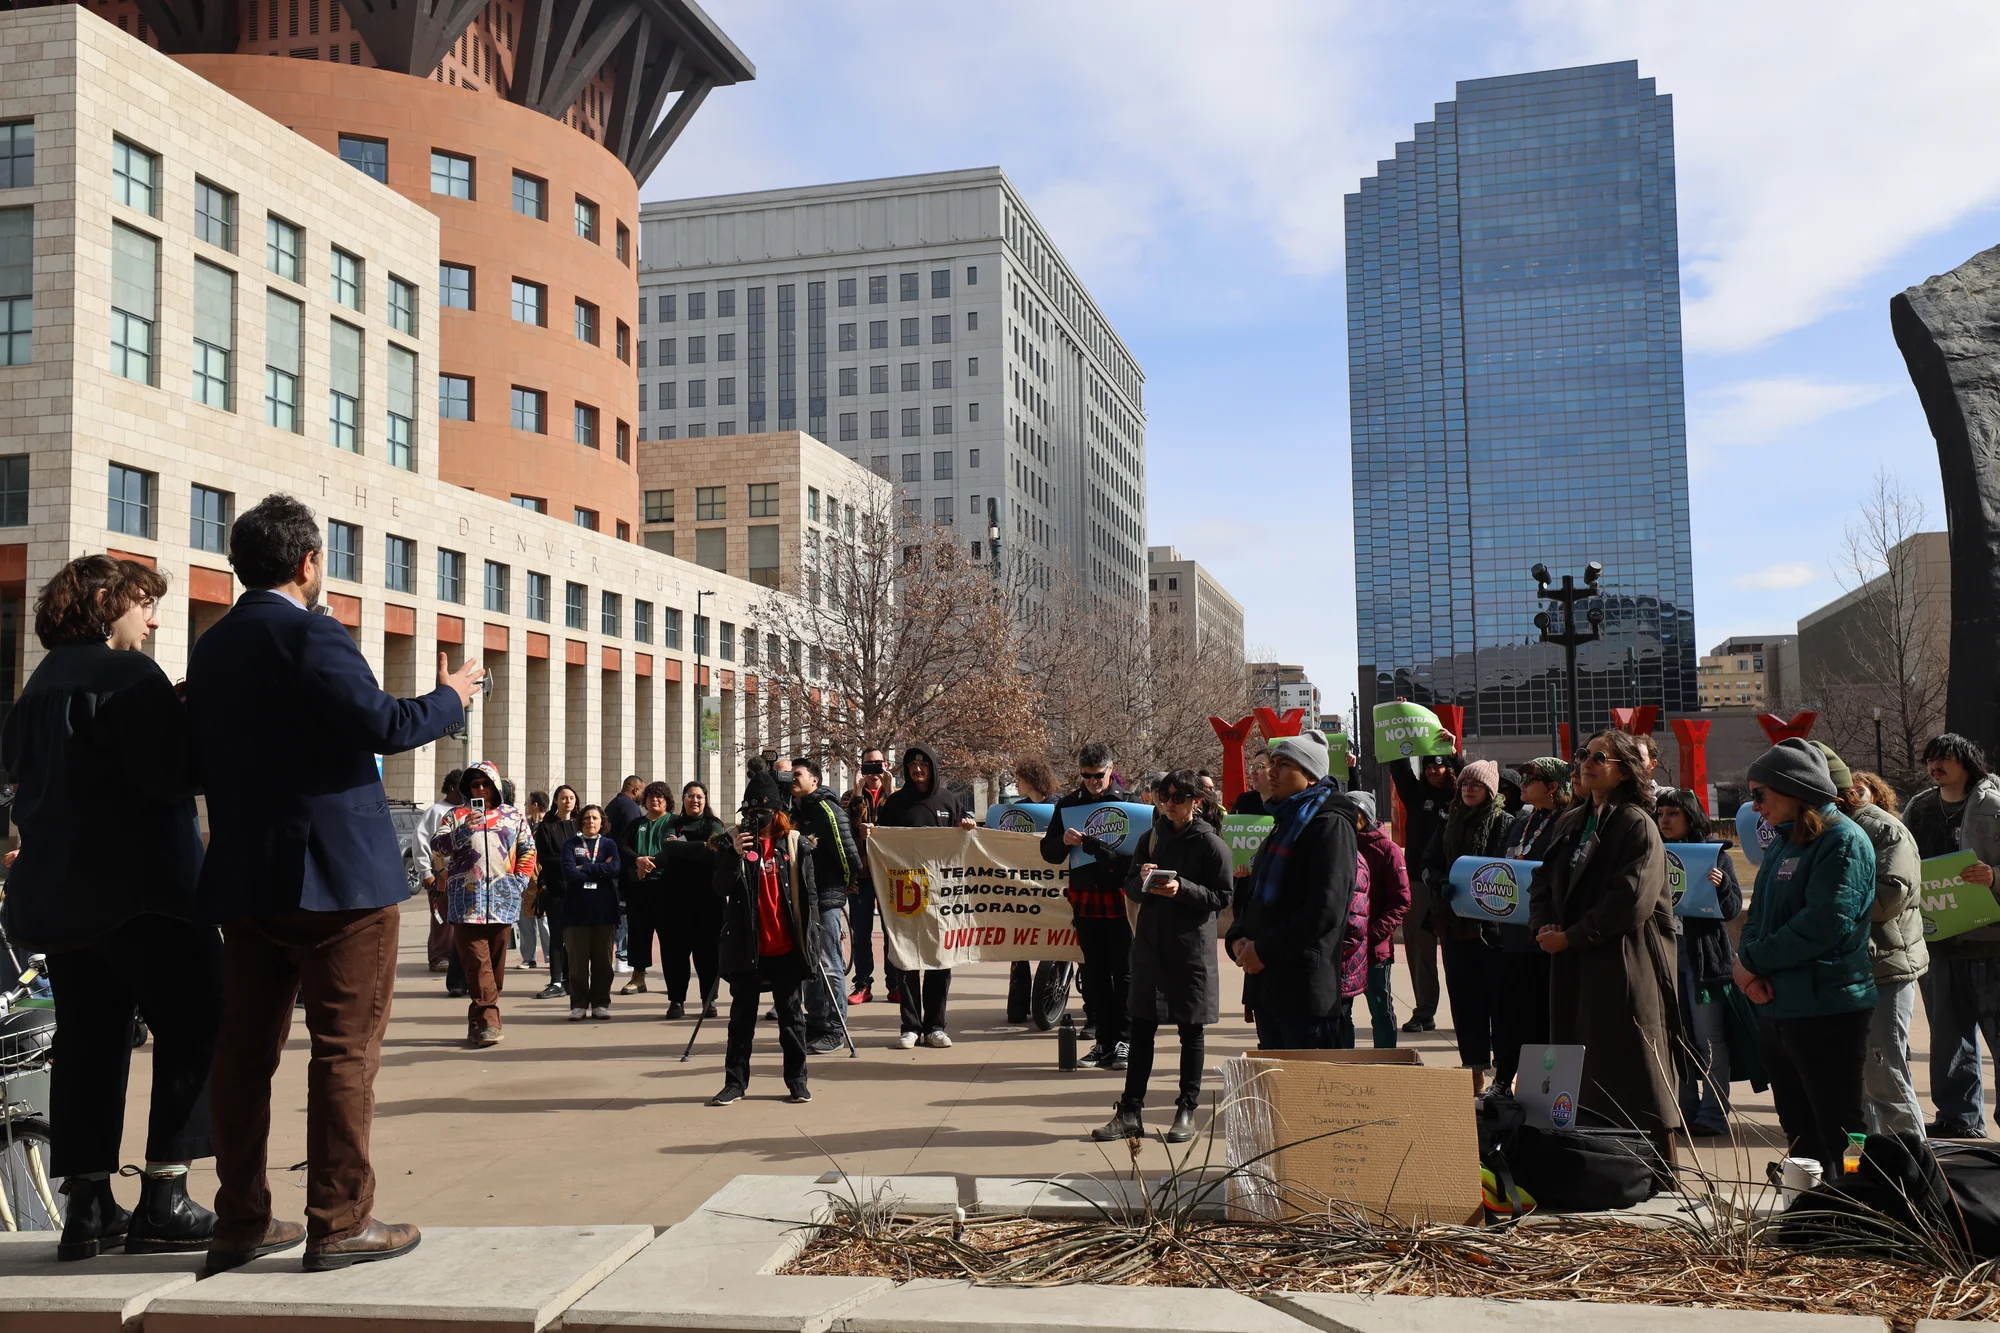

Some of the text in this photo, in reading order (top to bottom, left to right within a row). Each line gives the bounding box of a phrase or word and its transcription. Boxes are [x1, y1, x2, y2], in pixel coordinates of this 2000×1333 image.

[319, 474, 734, 612] THE DENVER PUBIC
[1375, 719, 1390, 729] FAIR
[1384, 726, 1430, 742] NOW!
[1088, 821, 1124, 837] DAMWU
[940, 867, 1055, 881] TEAMSTERS
[940, 884, 1060, 898] DEMOCRATIC
[1476, 882, 1514, 898] DAMWU
[940, 902, 1042, 916] COLORADO
[944, 926, 1006, 950] UNITED
[1013, 927, 1041, 945] WE
[1316, 1076, 1376, 1097] AFSCME
[1552, 1111, 1571, 1119] AFSCME
